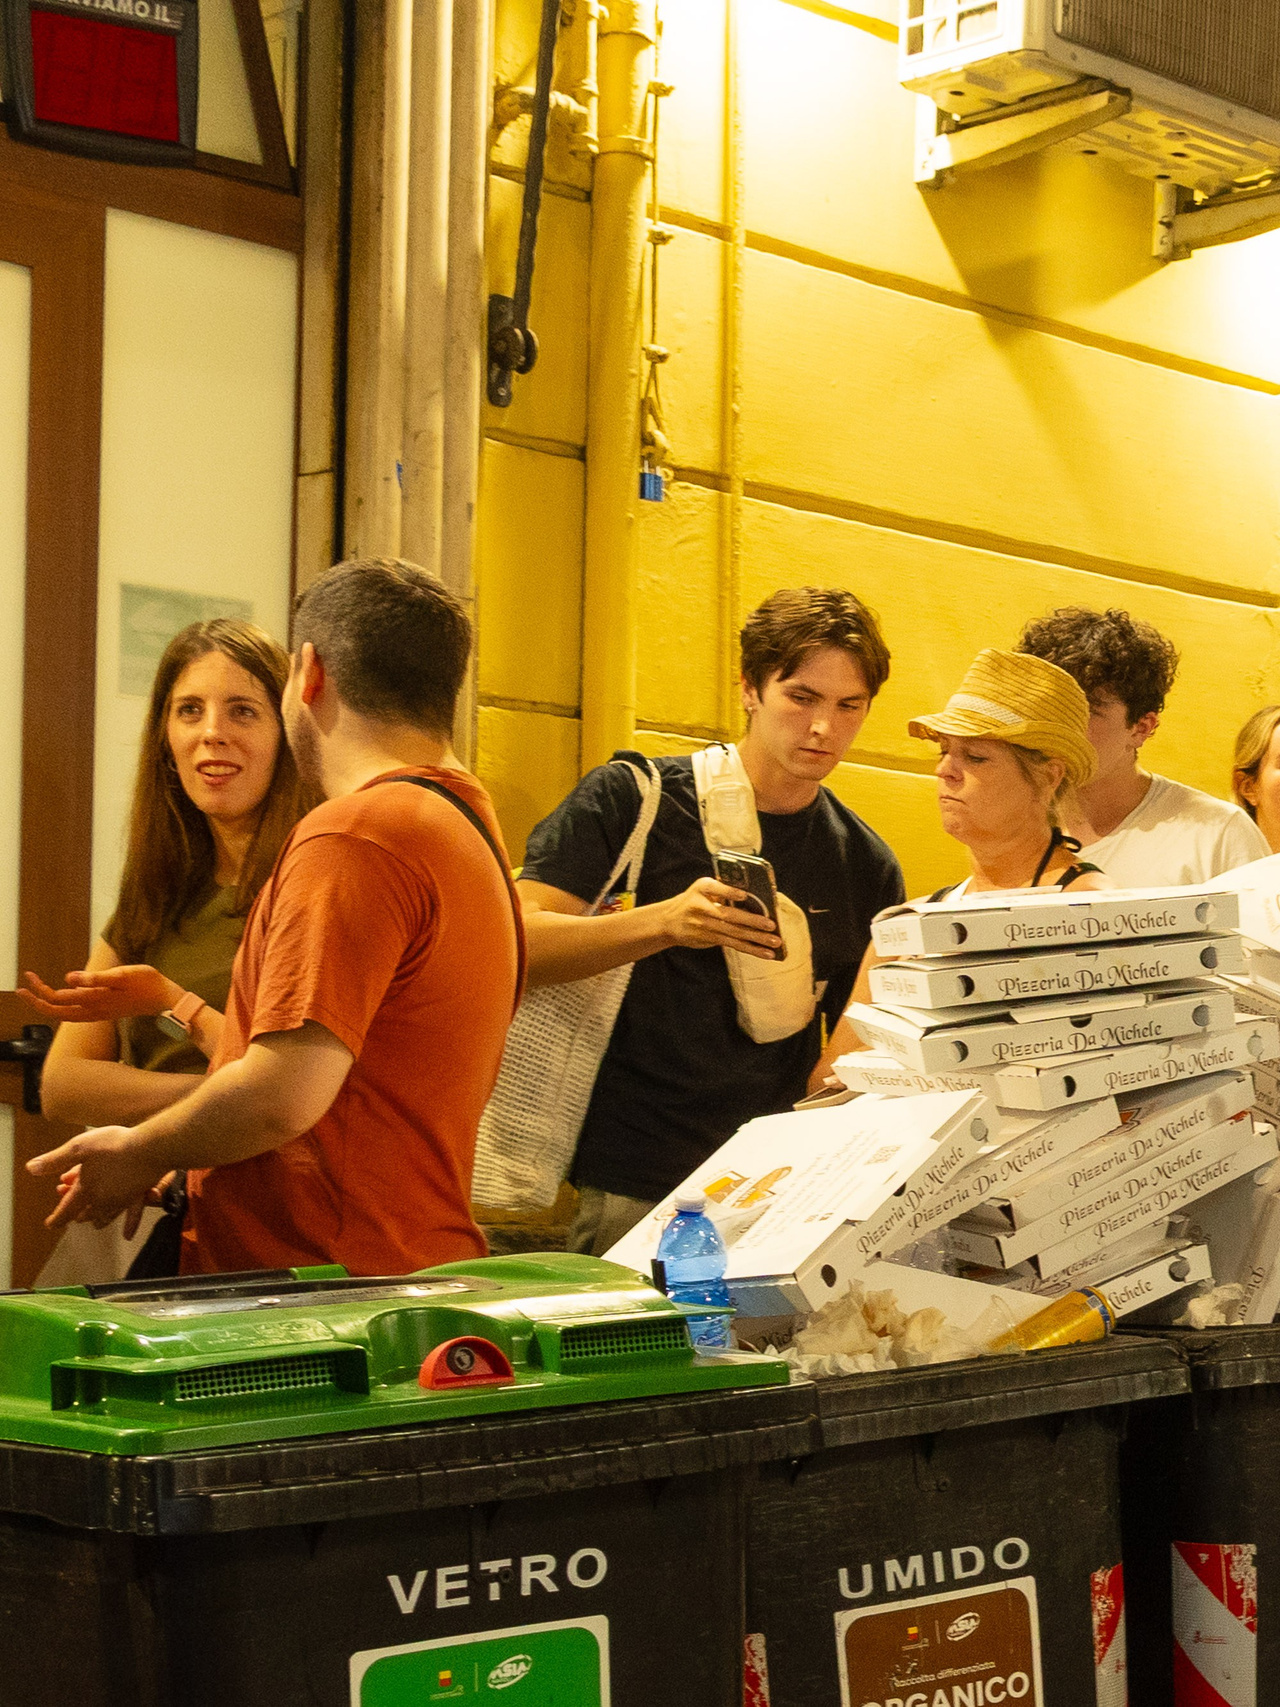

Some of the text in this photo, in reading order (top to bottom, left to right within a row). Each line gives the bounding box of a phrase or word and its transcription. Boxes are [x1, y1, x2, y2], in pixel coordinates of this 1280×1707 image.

[1004, 910, 1177, 947] Pizzeria Da Michele
[998, 961, 1170, 997] Pizzeria Da Michele
[992, 1021, 1162, 1062] Pizzeria Da Michele
[1104, 1048, 1235, 1095] Pizzeria Da Michele
[862, 1072, 912, 1087] Pizzeria
[914, 1074, 934, 1092] Da
[1068, 1109, 1206, 1195] Pizzeria Da Michele
[856, 1146, 966, 1254] Pizzeria Da Michele
[907, 1138, 1055, 1235] Pizzeria Da Michele
[1060, 1148, 1203, 1233] Pizzeria Da Michele
[1093, 1159, 1231, 1245] Pizzeria Da Michele
[386, 1548, 608, 1614] VETRO
[838, 1537, 1030, 1599] UMIDO
